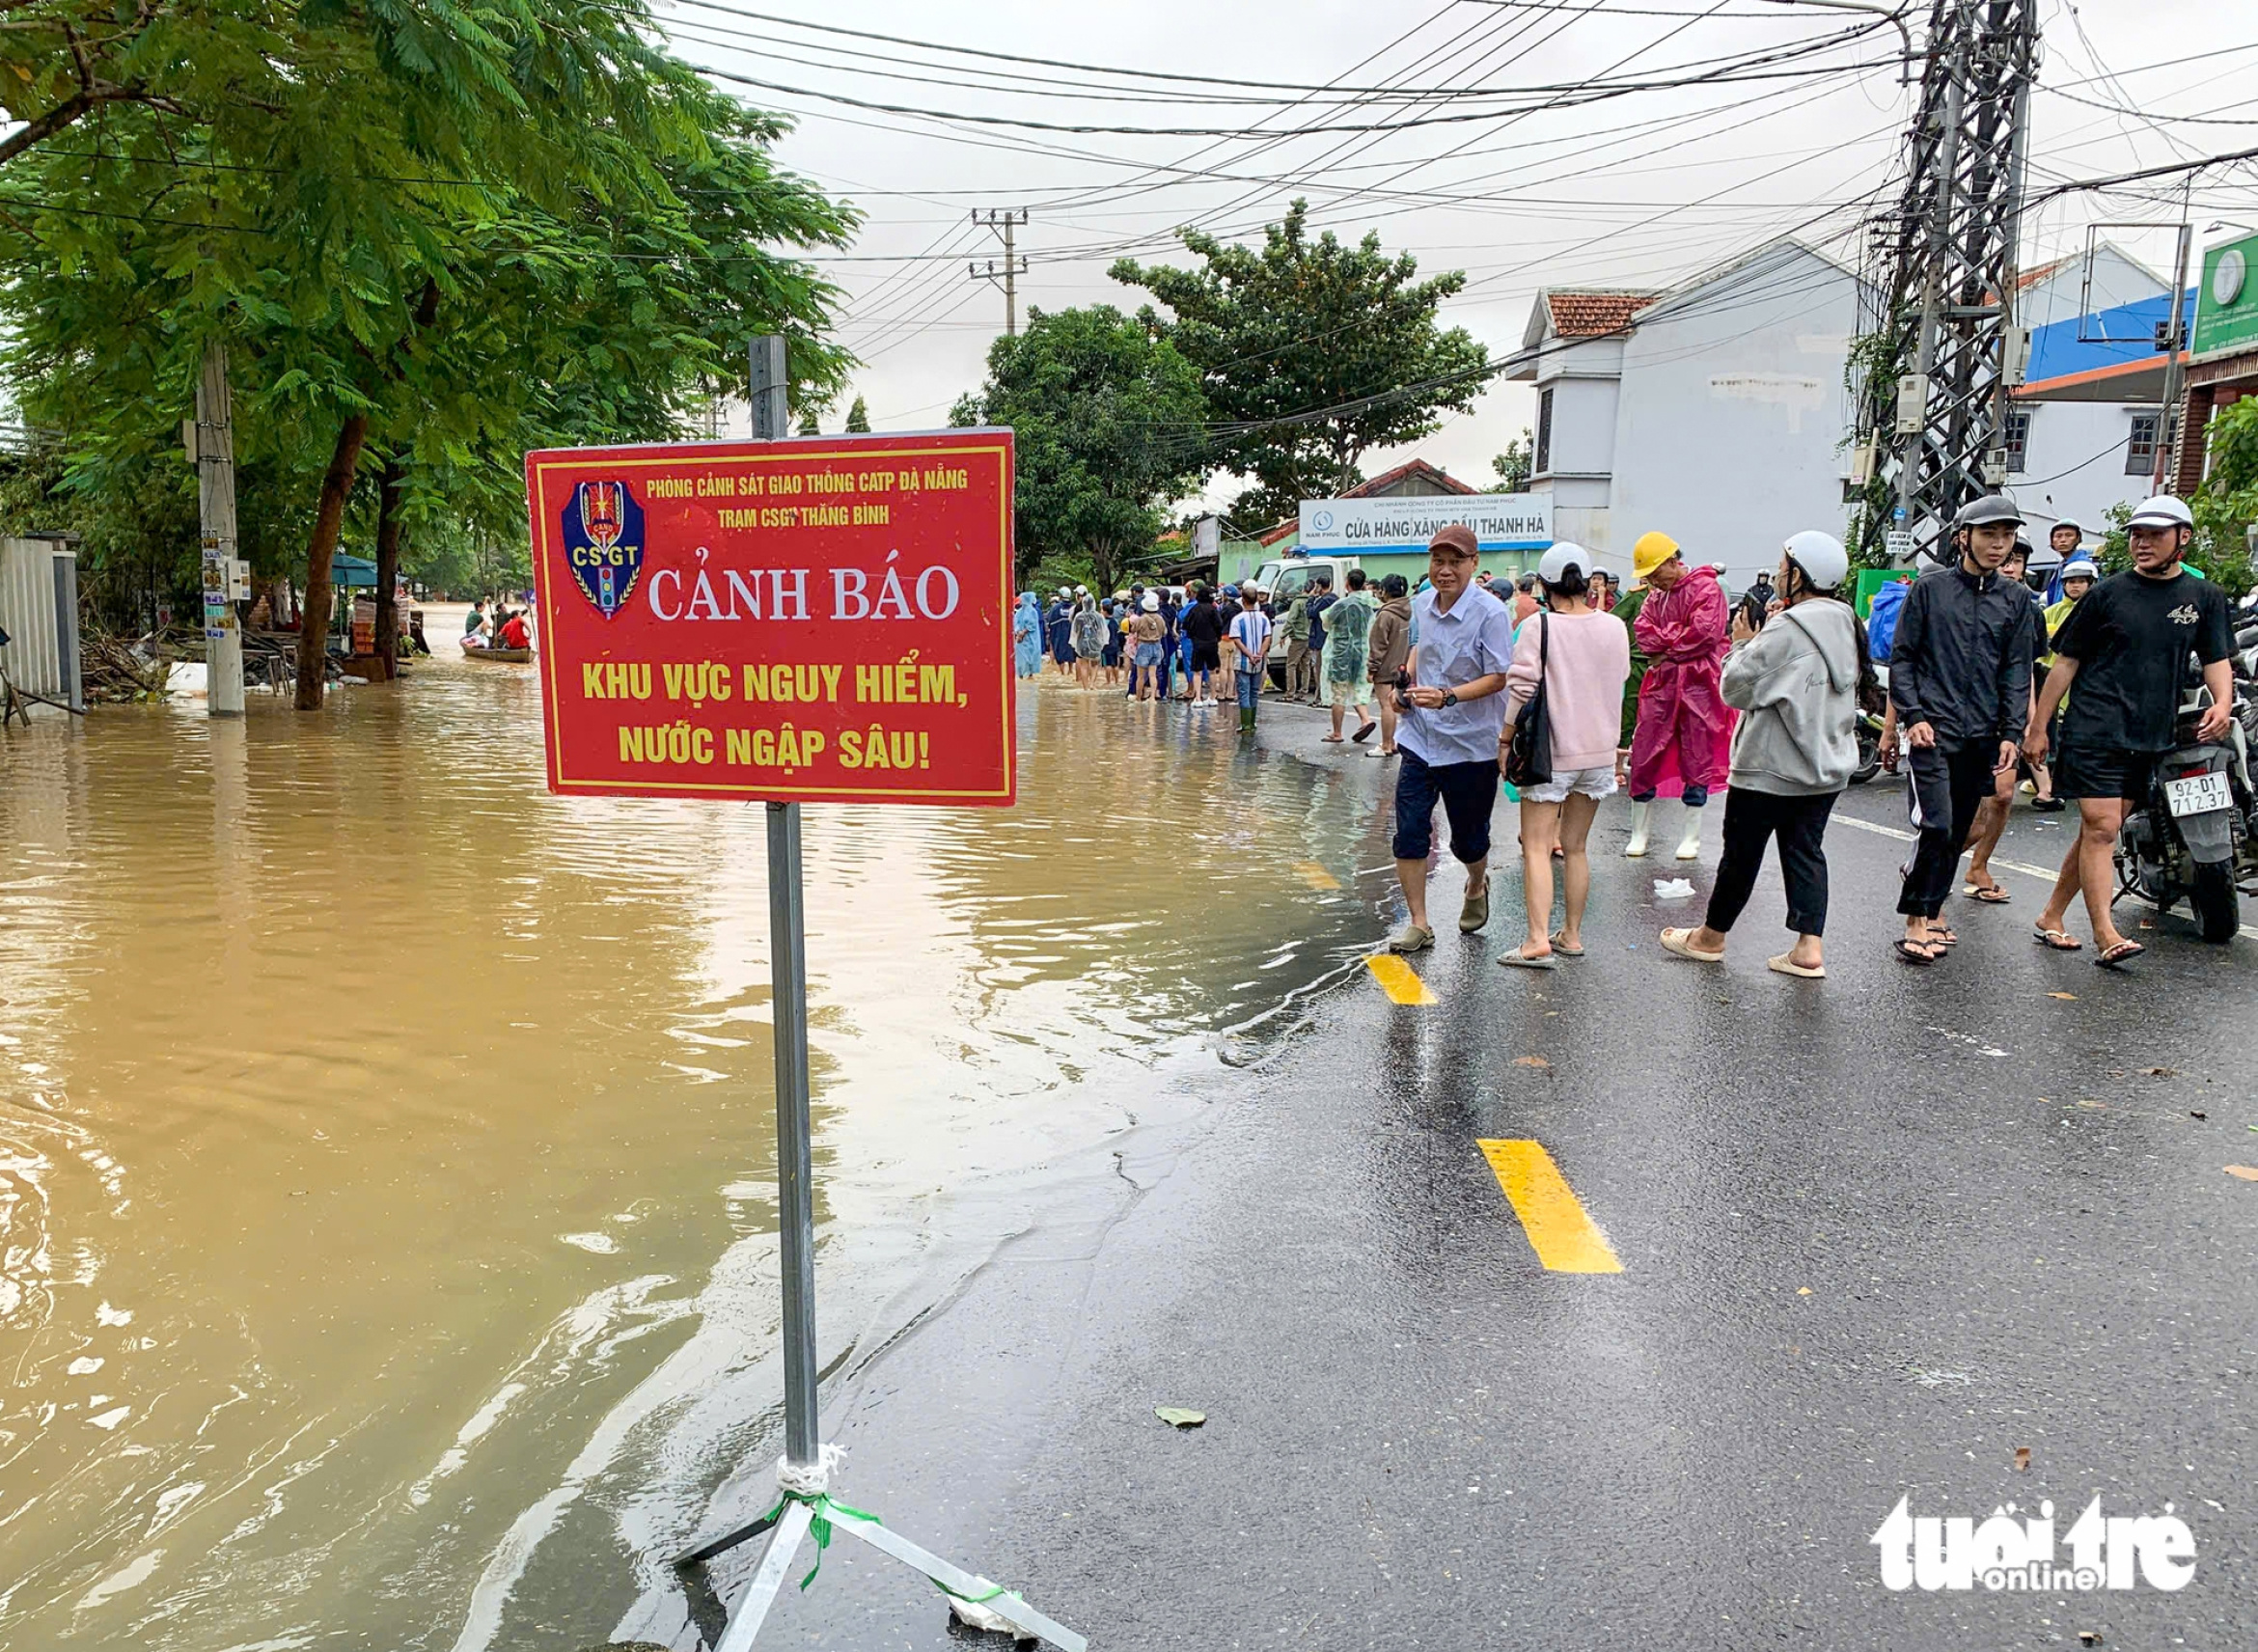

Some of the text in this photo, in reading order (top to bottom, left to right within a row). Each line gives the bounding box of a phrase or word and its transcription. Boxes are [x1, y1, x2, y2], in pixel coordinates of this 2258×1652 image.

[647, 462, 968, 498] PHÒNG CẢNH SÁT GIAO THÔNG CATP ĐÀ NẴNG
[718, 501, 890, 532] TRẠM CSGT THĂNG BÌNH
[1345, 516, 1370, 538] CỬA
[1374, 516, 1409, 537] HÀNG
[1480, 517, 1523, 534] THANH
[1527, 512, 1544, 533] HÀ
[572, 546, 638, 566] CSGT
[648, 546, 959, 620] CẢNH BÁO
[582, 648, 968, 709] KHU VỰC NGUY HIỂM,
[619, 719, 930, 775] NƯỚC NGẬP SÂU!
[2173, 790, 2225, 814] 712.37
[2175, 776, 2217, 797] 92-D1
